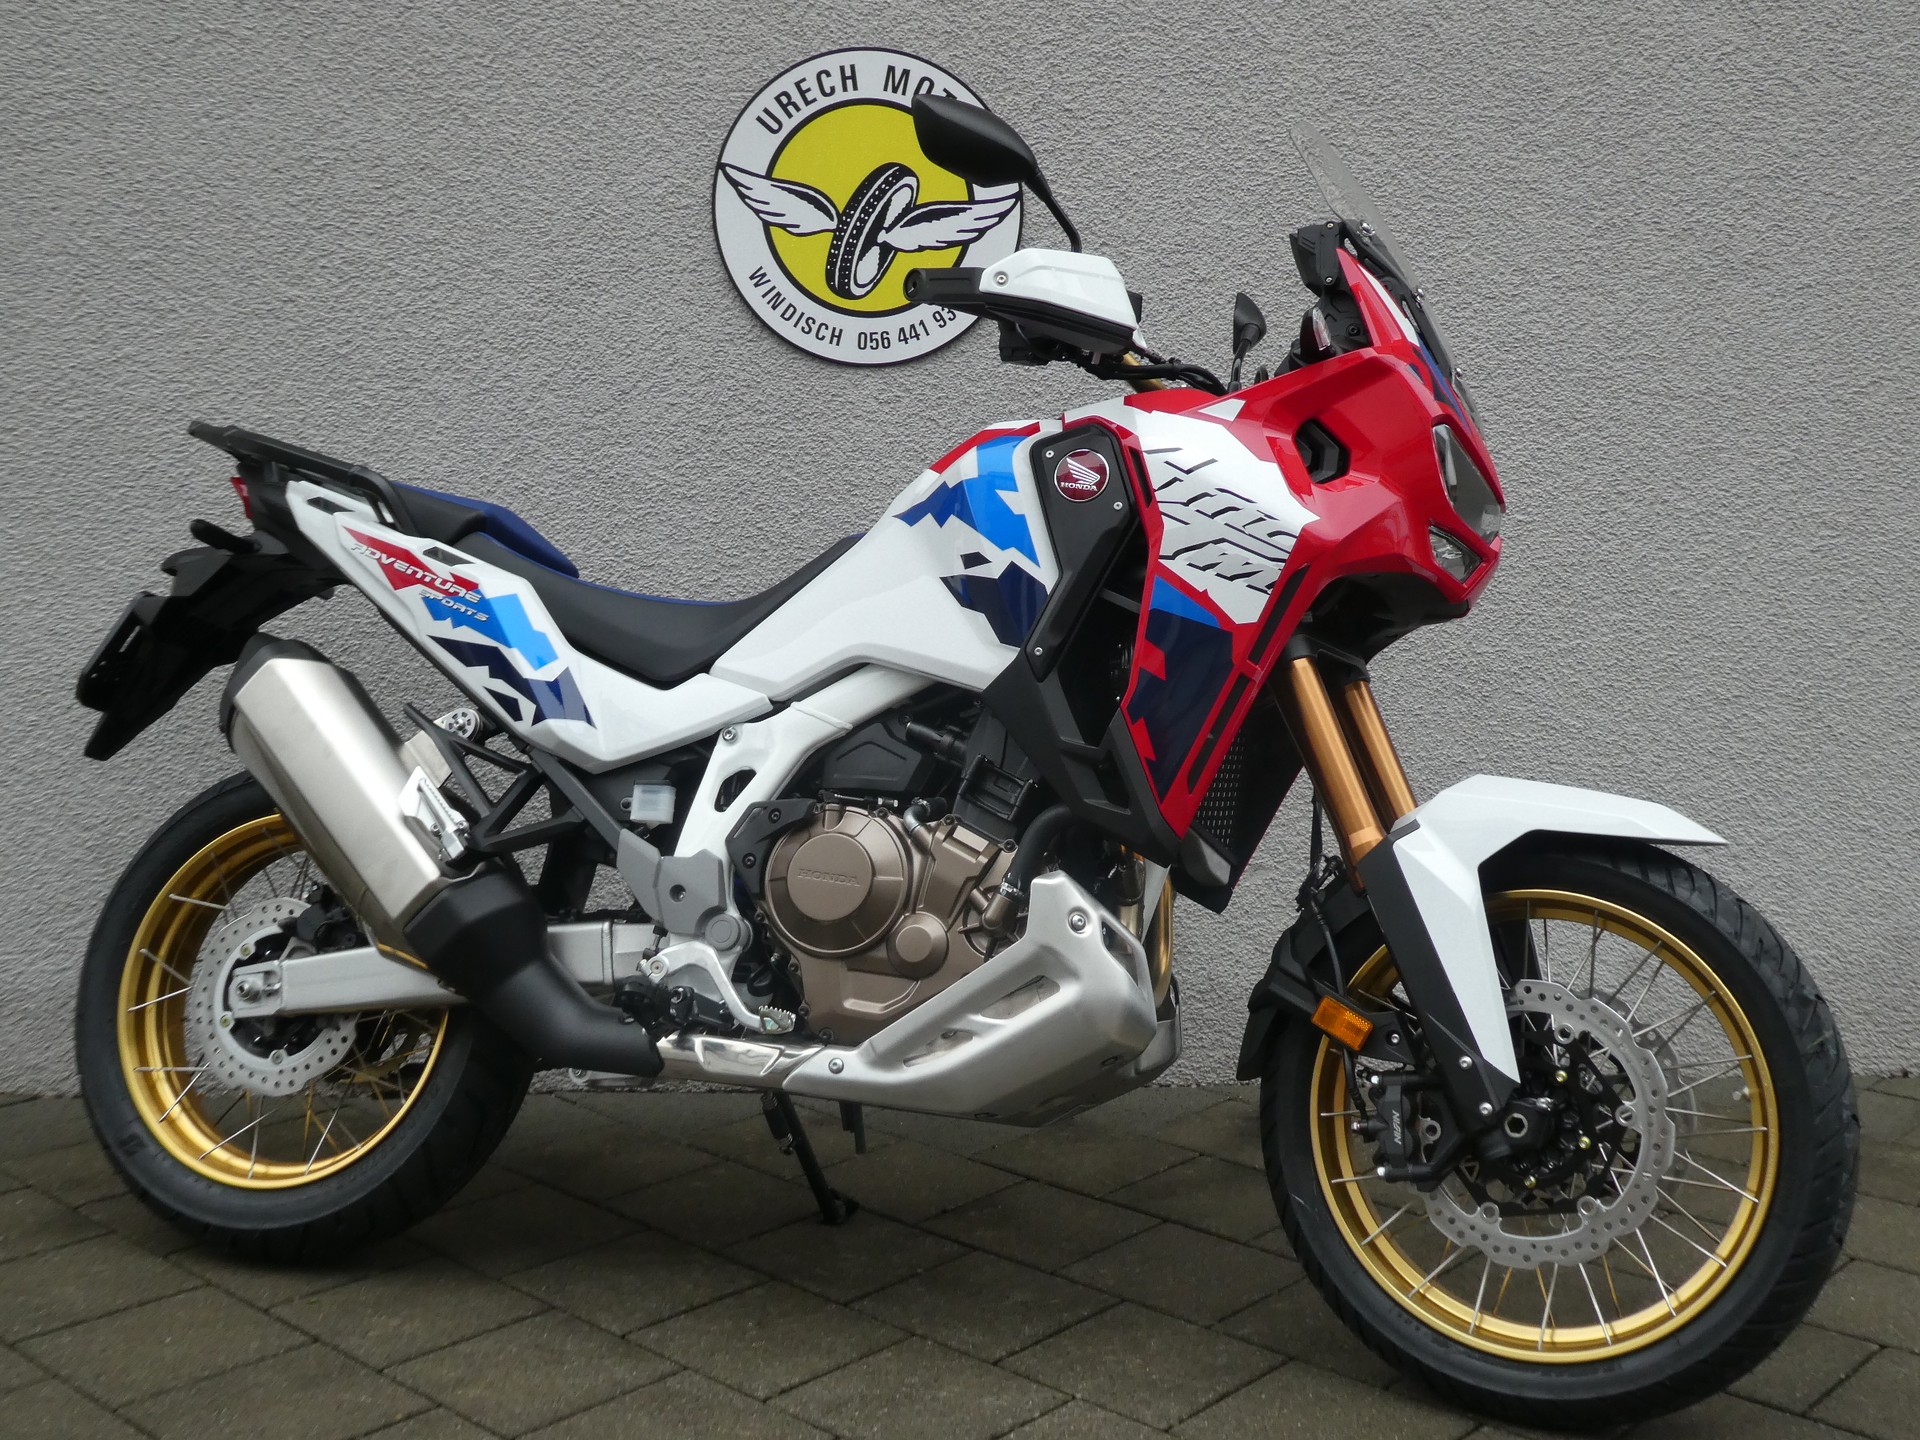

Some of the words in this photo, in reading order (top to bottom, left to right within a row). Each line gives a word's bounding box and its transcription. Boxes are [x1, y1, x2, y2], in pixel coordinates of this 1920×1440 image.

[755, 64, 859, 135] URECH
[748, 265, 844, 347] WINDISCH
[857, 331, 891, 350] 056
[898, 319, 930, 345] 441
[1060, 481, 1098, 492] HONDA
[350, 543, 482, 604] ADVENTURE
[419, 589, 489, 622] SPORTS
[797, 868, 861, 887] HONDA
